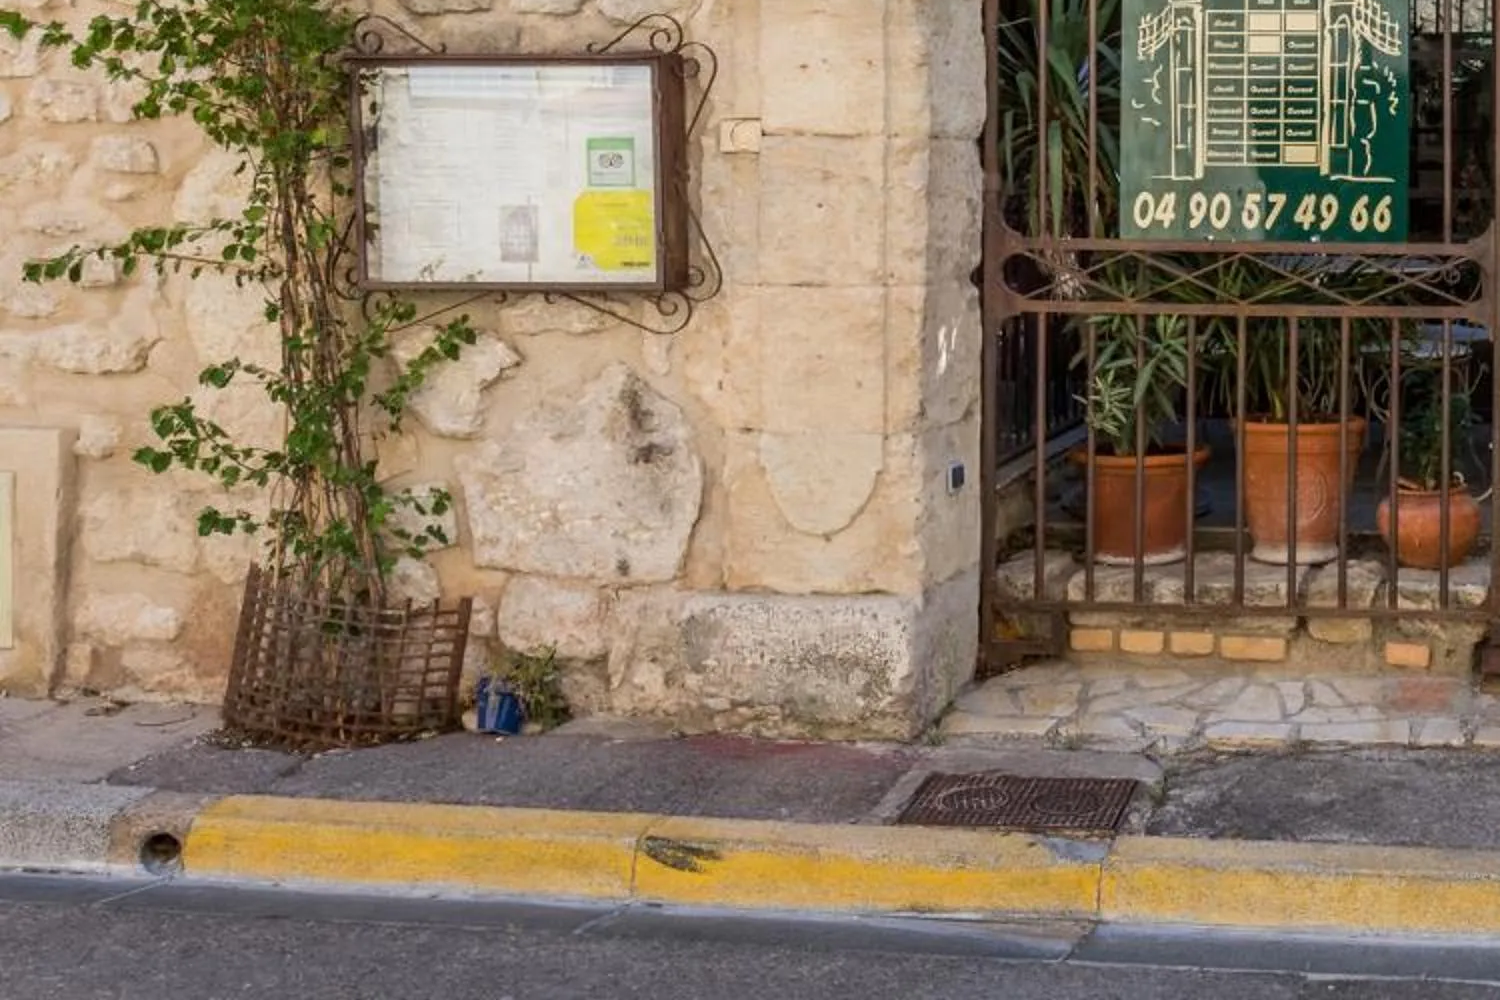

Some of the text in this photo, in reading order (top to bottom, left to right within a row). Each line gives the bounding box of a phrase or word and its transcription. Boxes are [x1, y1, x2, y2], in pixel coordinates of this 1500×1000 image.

[1133, 191, 1393, 233] 04 90 57 49 66
